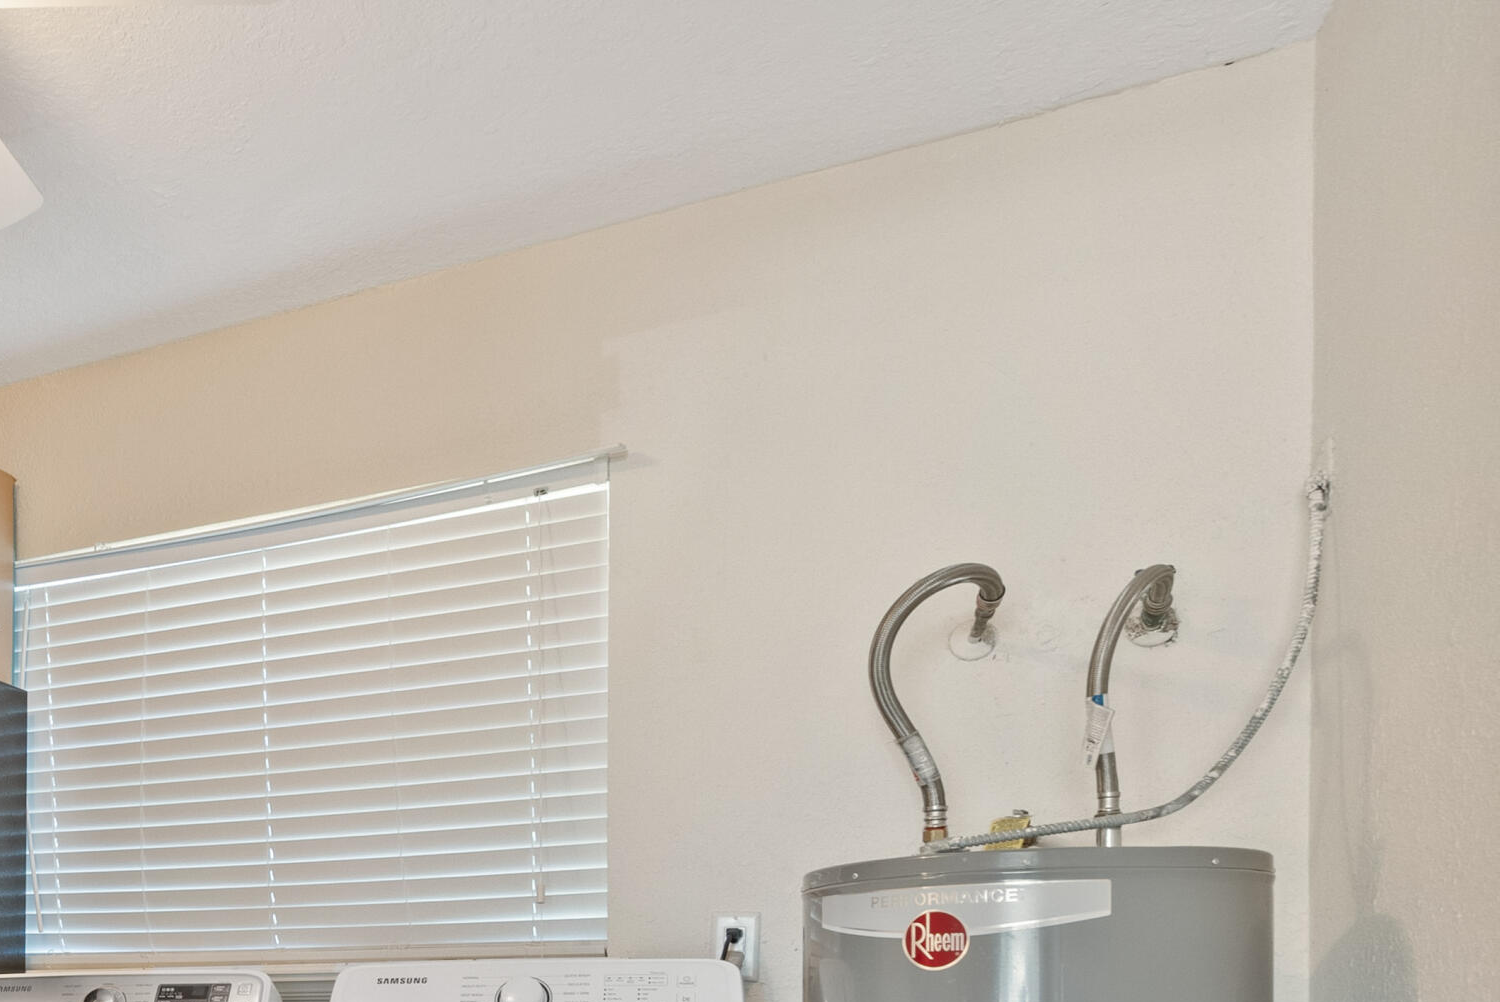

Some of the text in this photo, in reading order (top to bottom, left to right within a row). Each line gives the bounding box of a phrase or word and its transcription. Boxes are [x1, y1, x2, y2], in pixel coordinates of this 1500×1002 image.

[870, 887, 1019, 909] PERFORMANCE
[910, 911, 965, 961] Rheem
[376, 976, 429, 985] SAMSUNG
